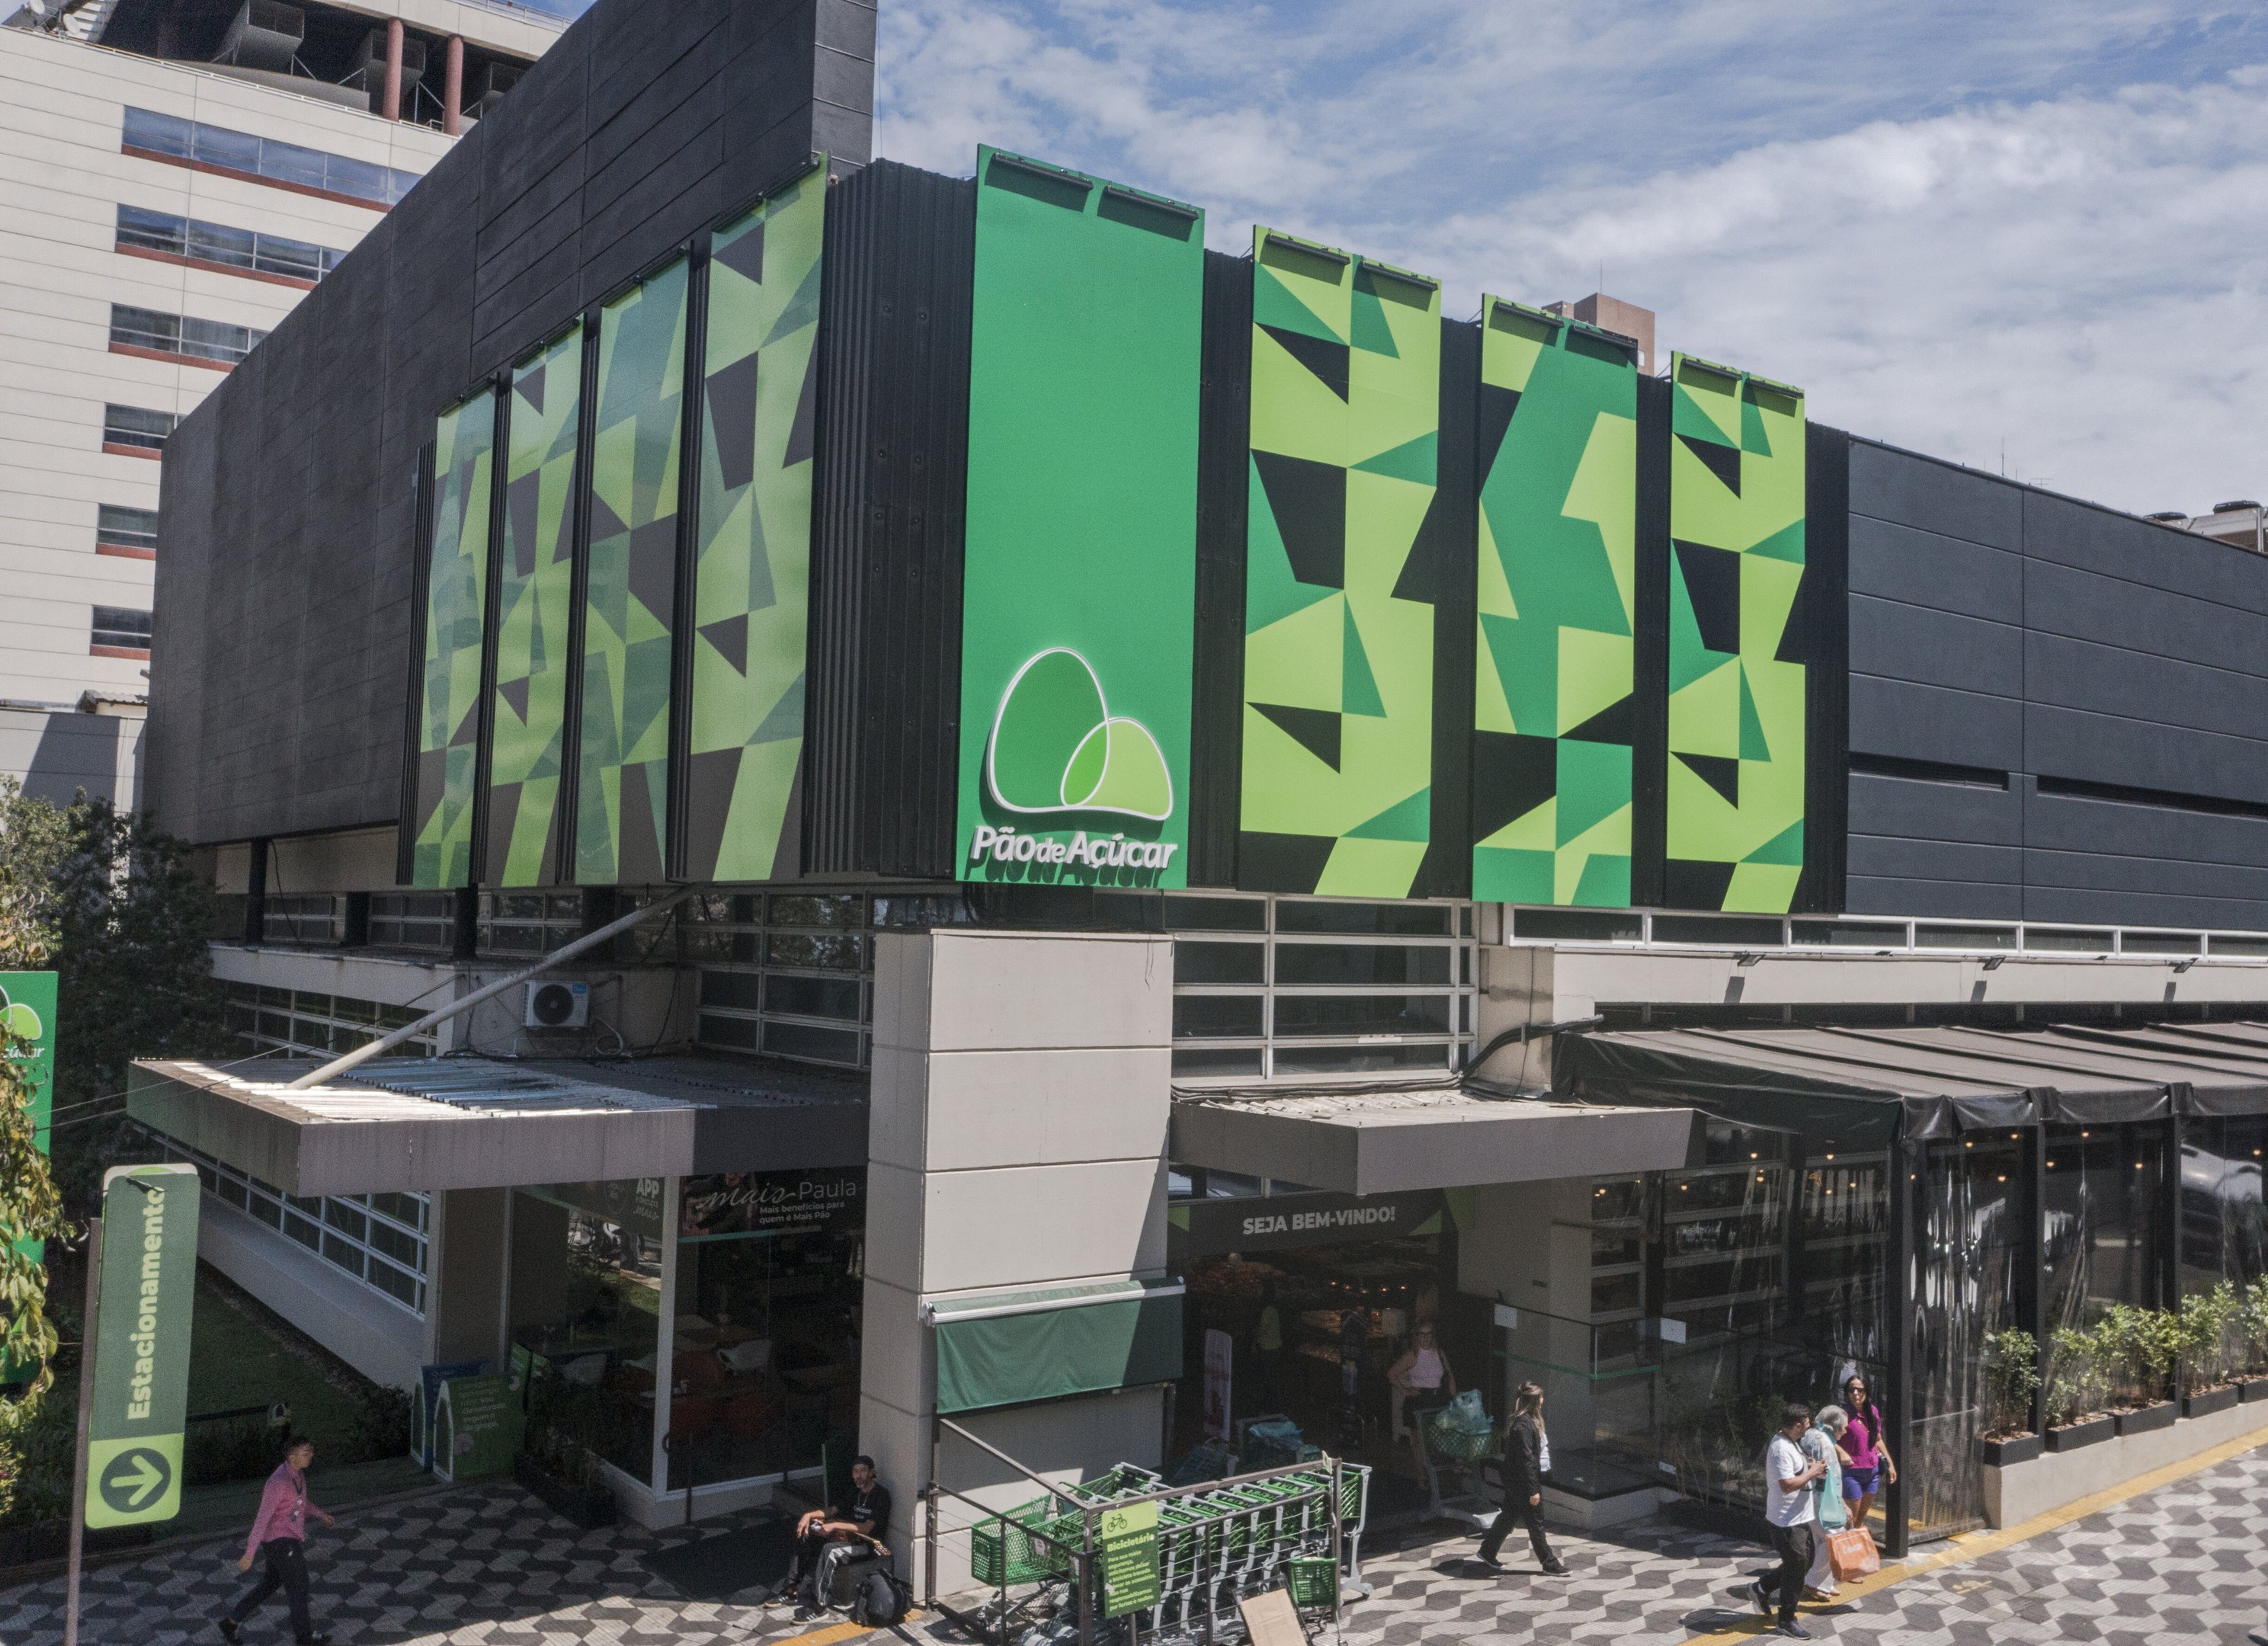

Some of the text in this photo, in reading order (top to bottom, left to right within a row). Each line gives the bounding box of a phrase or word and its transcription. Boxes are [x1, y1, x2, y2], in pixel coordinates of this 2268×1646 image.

[636, 1178, 659, 1199] APP
[799, 1179, 857, 1200] Paula
[759, 1215, 784, 1225] quem
[793, 1212, 813, 1220] Mais
[760, 1202, 845, 1214] Mais benefícios para
[1243, 1206, 1395, 1234] SEJA BEM-VINDO!
[127, 1186, 165, 1420] Estacionamento
